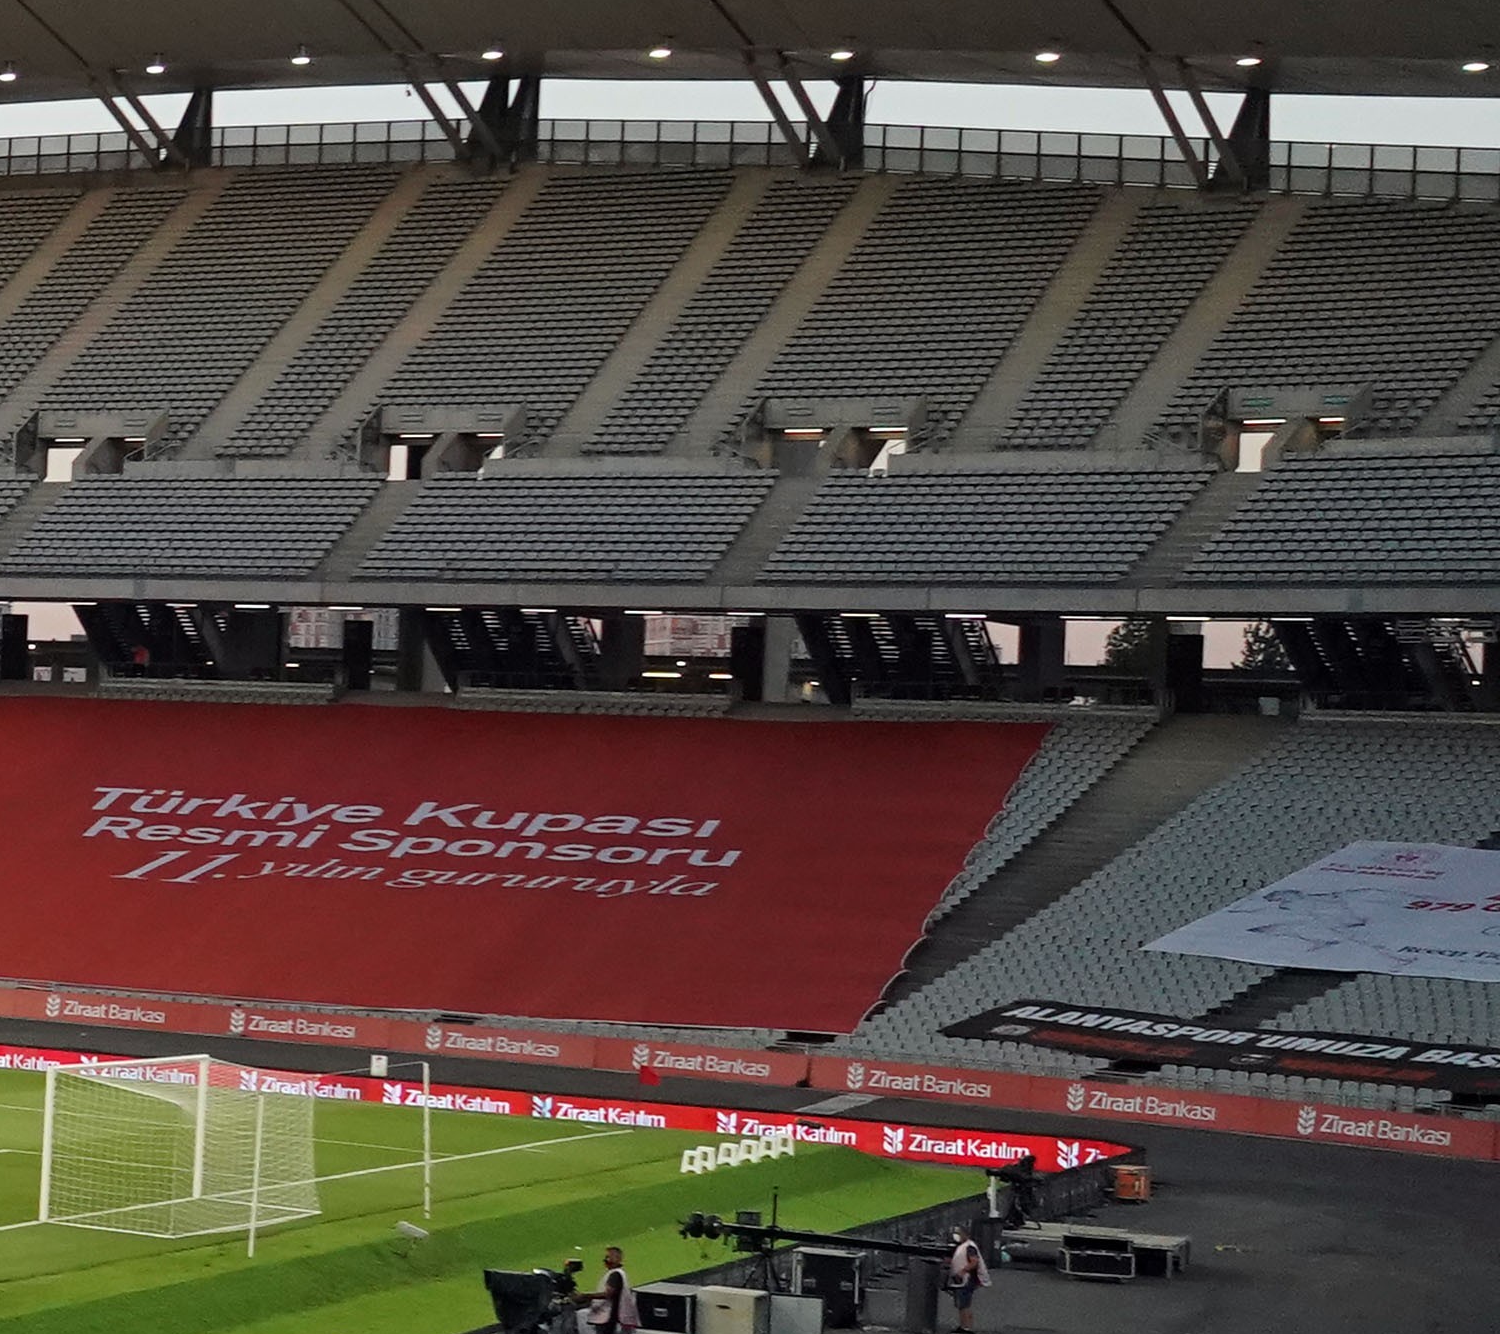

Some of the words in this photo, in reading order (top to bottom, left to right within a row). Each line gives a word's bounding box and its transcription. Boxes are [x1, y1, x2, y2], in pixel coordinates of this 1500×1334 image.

[90, 786, 384, 826] Türkiye
[403, 801, 720, 839] Kupası
[82, 815, 328, 849] Resmi
[338, 828, 742, 868] Sponsoru
[238, 857, 386, 882] yılın
[385, 863, 719, 898] gururuyla
[64, 999, 107, 1018] Ziraat
[108, 1003, 165, 1024] Bankası
[247, 1015, 294, 1034] Ziraat
[295, 1018, 355, 1039] Bankası
[444, 1031, 494, 1052] Ziraat
[495, 1036, 560, 1058] Bankası
[12, 1053, 60, 1070] Katılım
[653, 1050, 703, 1070] Ziraat
[704, 1054, 771, 1077] Bankası
[868, 1070, 922, 1092] Ziraat
[923, 1075, 992, 1098] Bankası
[556, 1103, 606, 1124] Ziraat
[607, 1107, 666, 1128] Katılım
[1088, 1091, 1143, 1114] Ziraat
[1144, 1096, 1217, 1122] Bankası
[1320, 1114, 1375, 1138] Ziraat
[1377, 1120, 1452, 1147] Bankası
[909, 1135, 966, 1156] Ziraat
[967, 1138, 1030, 1159] Katılım
